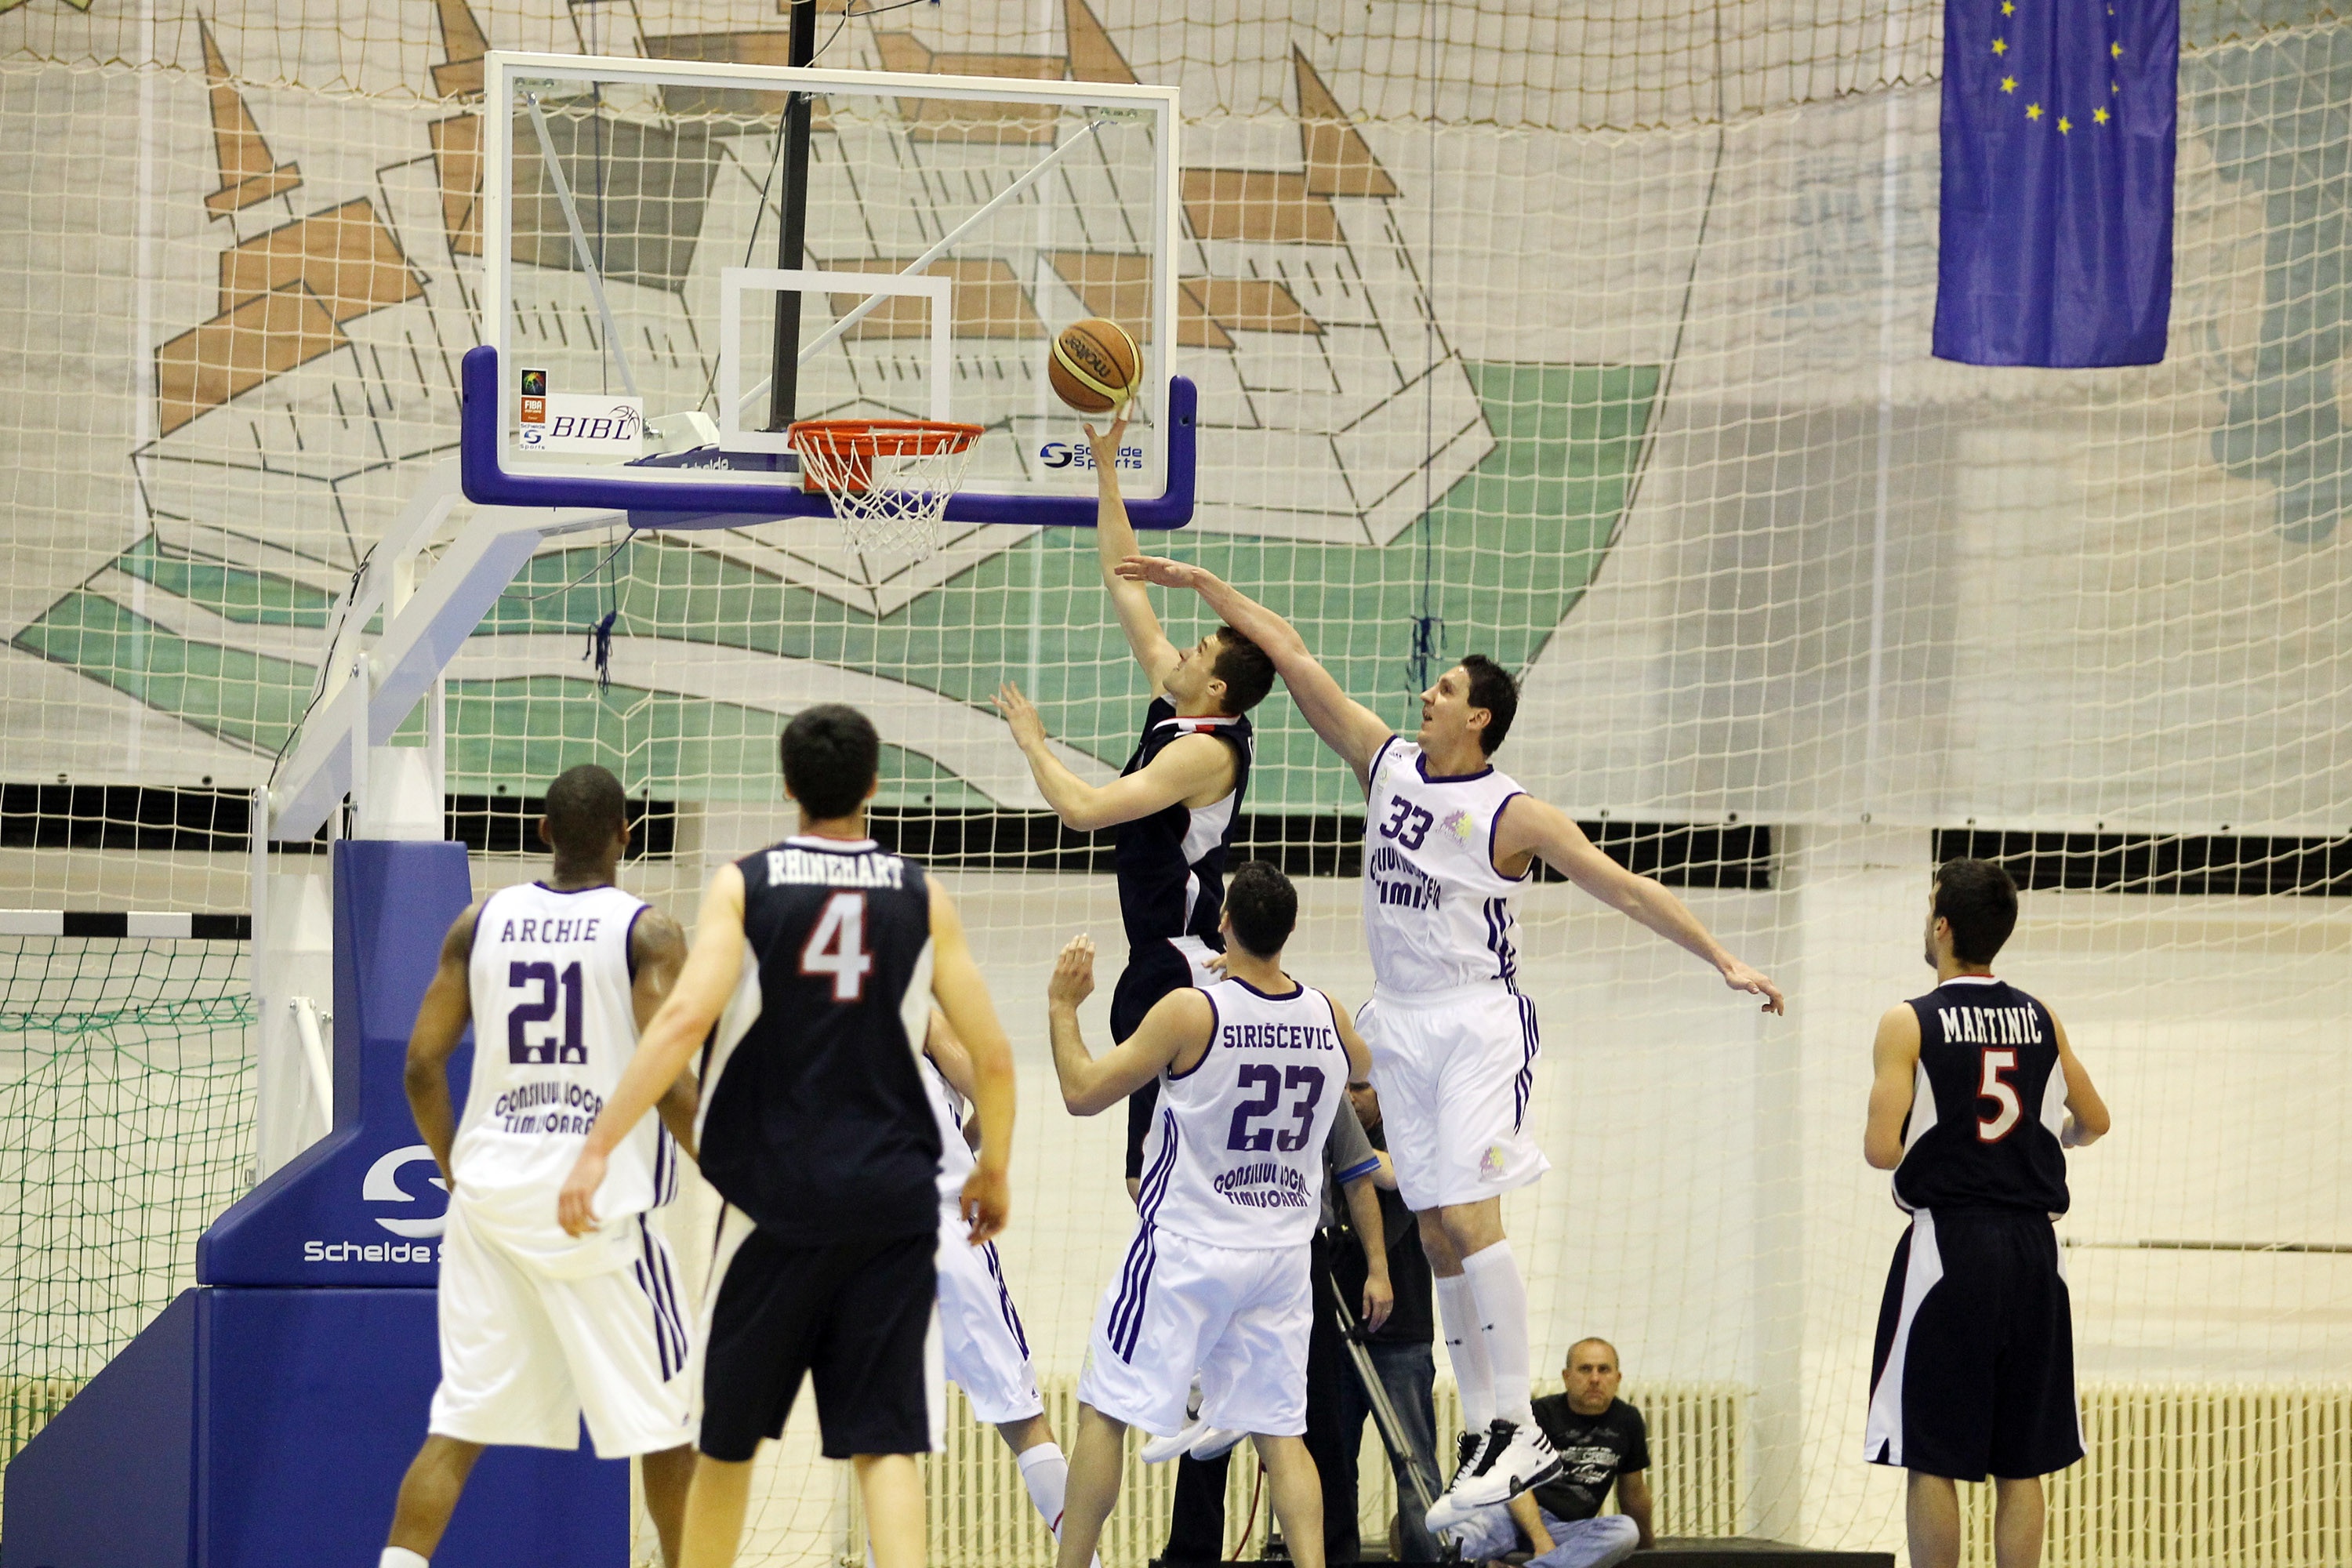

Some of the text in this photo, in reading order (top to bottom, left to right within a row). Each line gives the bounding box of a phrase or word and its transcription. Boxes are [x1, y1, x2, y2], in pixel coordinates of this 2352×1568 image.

[524, 400, 543, 410] FIBA
[549, 416, 631, 440] BIBL
[1074, 444, 1142, 457] Sclde
[1074, 456, 1142, 470] Sprts
[1379, 794, 1434, 851] 33
[767, 848, 904, 891] RHINEHART
[501, 918, 601, 943] ARCHIE
[798, 889, 874, 1004] 4
[508, 960, 588, 1065] 21
[1223, 1022, 1334, 1051] SIRIŠČEVIĆ
[1226, 1063, 1326, 1152] 23
[1976, 1047, 2024, 1144] 5
[1224, 1189, 1308, 1208] TIMISOARA
[304, 1240, 430, 1263] Schelde
